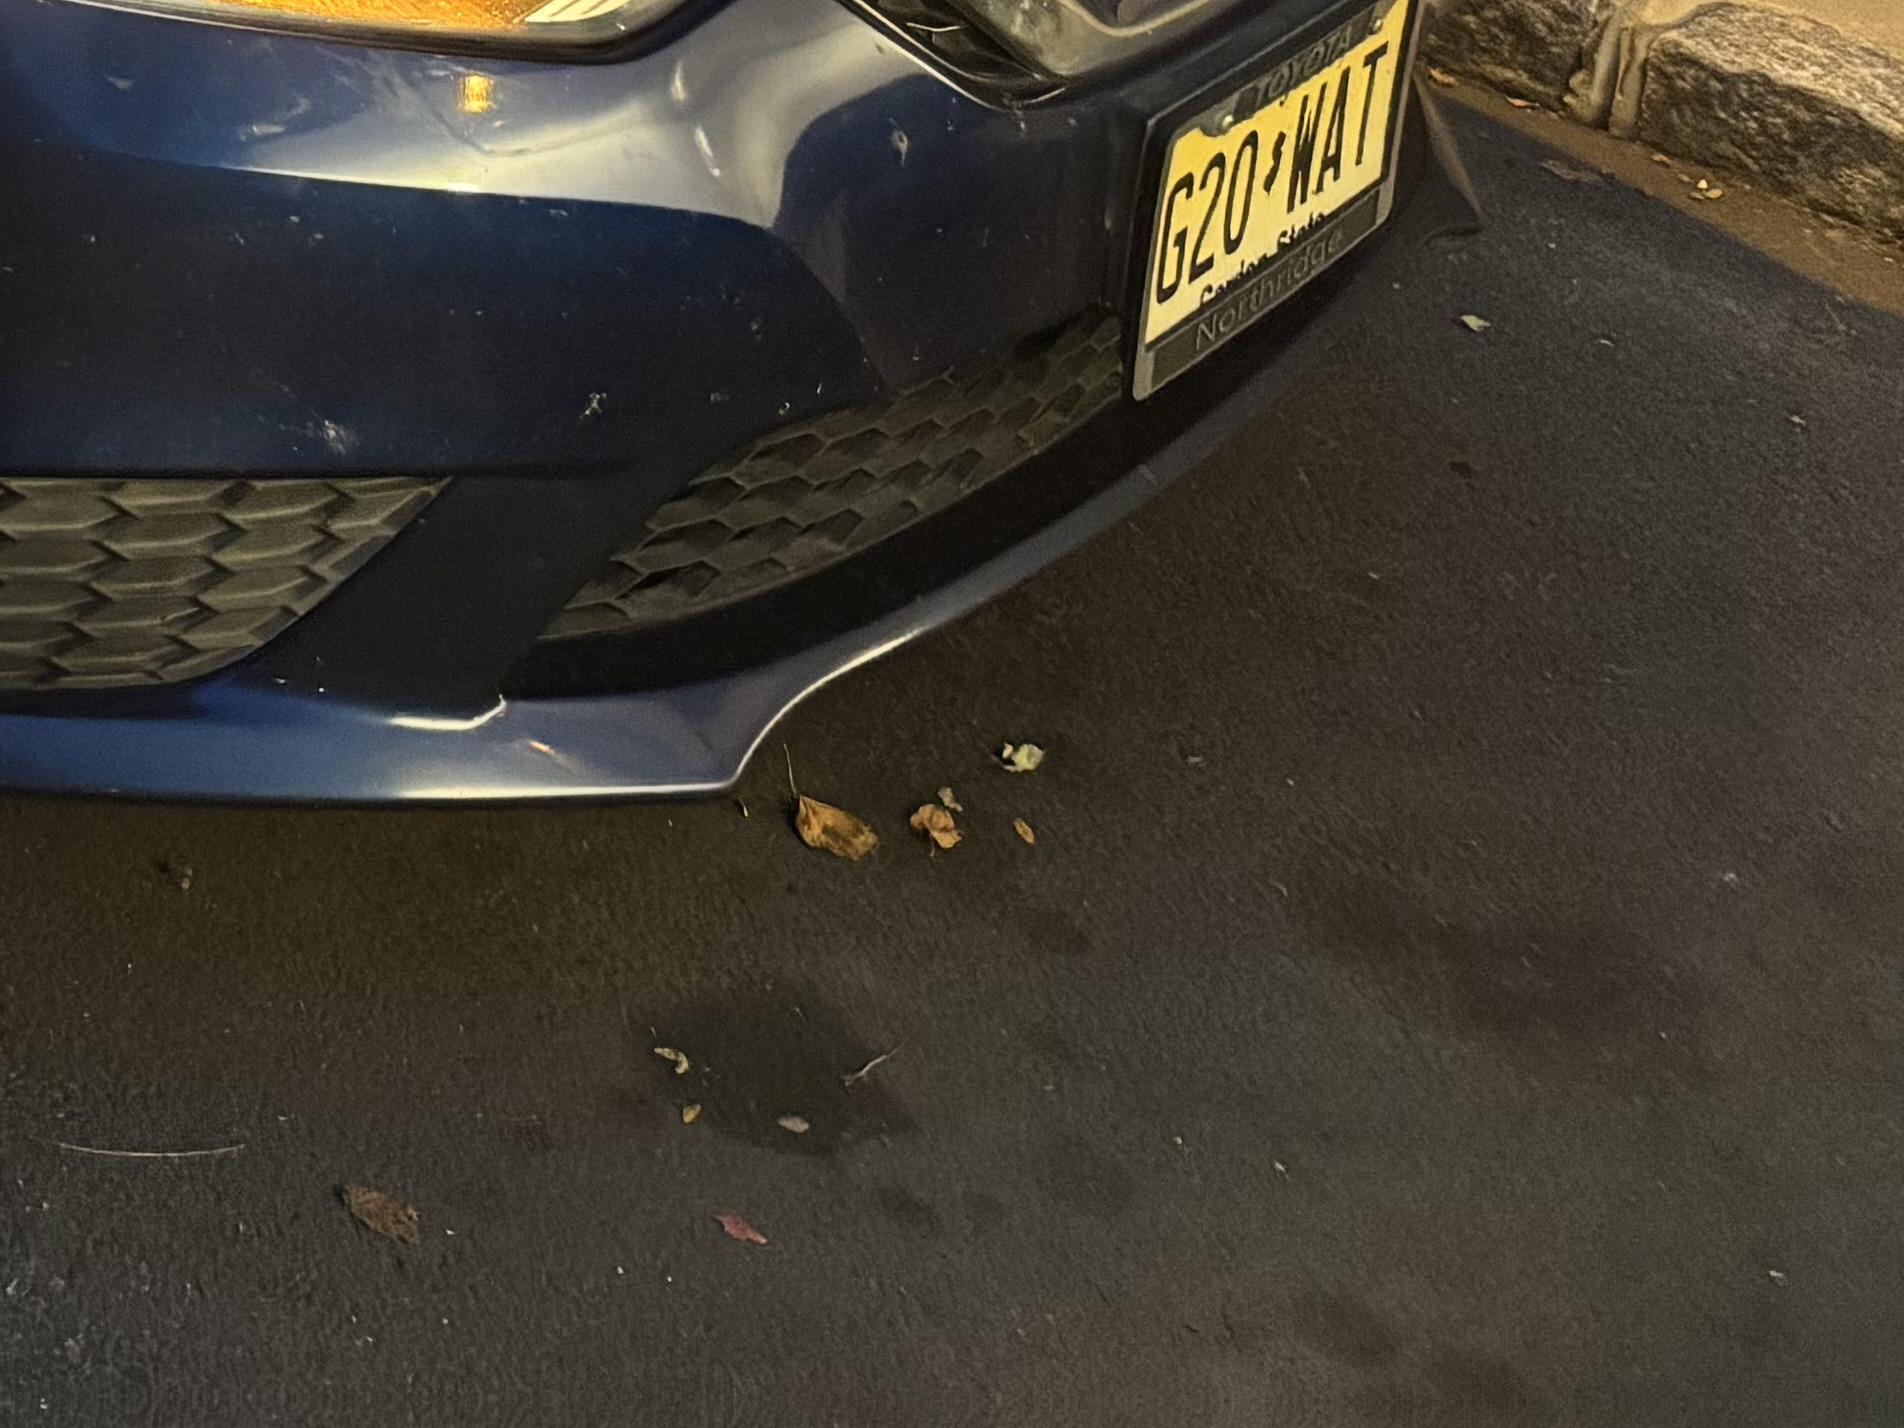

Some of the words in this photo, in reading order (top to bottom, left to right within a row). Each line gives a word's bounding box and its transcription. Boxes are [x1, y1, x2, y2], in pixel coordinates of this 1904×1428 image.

[1254, 22, 1353, 109] TOYOTA
[1155, 129, 1260, 305] G20
[1286, 40, 1390, 215] WAT
[1195, 228, 1344, 351] Northridge
